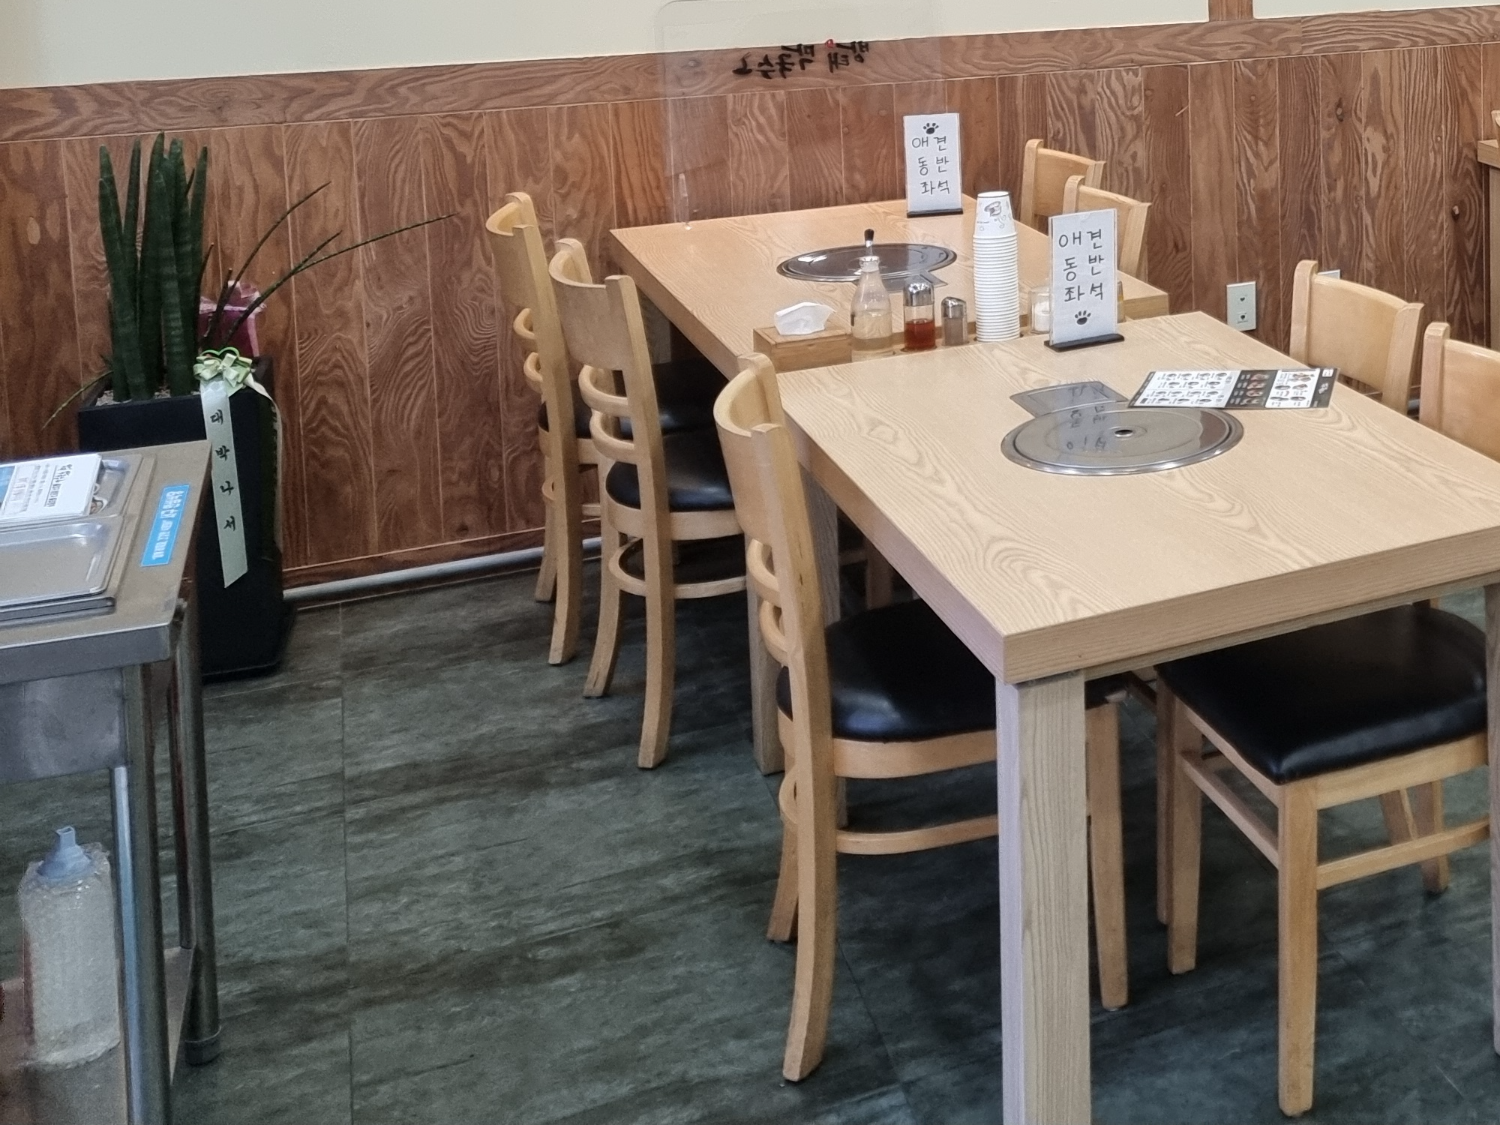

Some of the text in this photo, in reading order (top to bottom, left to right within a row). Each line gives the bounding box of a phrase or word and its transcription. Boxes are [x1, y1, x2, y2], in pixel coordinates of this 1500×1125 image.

[911, 135, 948, 151] 애견
[918, 156, 950, 176] 동반
[921, 180, 950, 195] 좌석
[1058, 228, 1103, 250] 애견
[1063, 254, 1105, 282] 동반
[1064, 282, 1104, 302] 좌석
